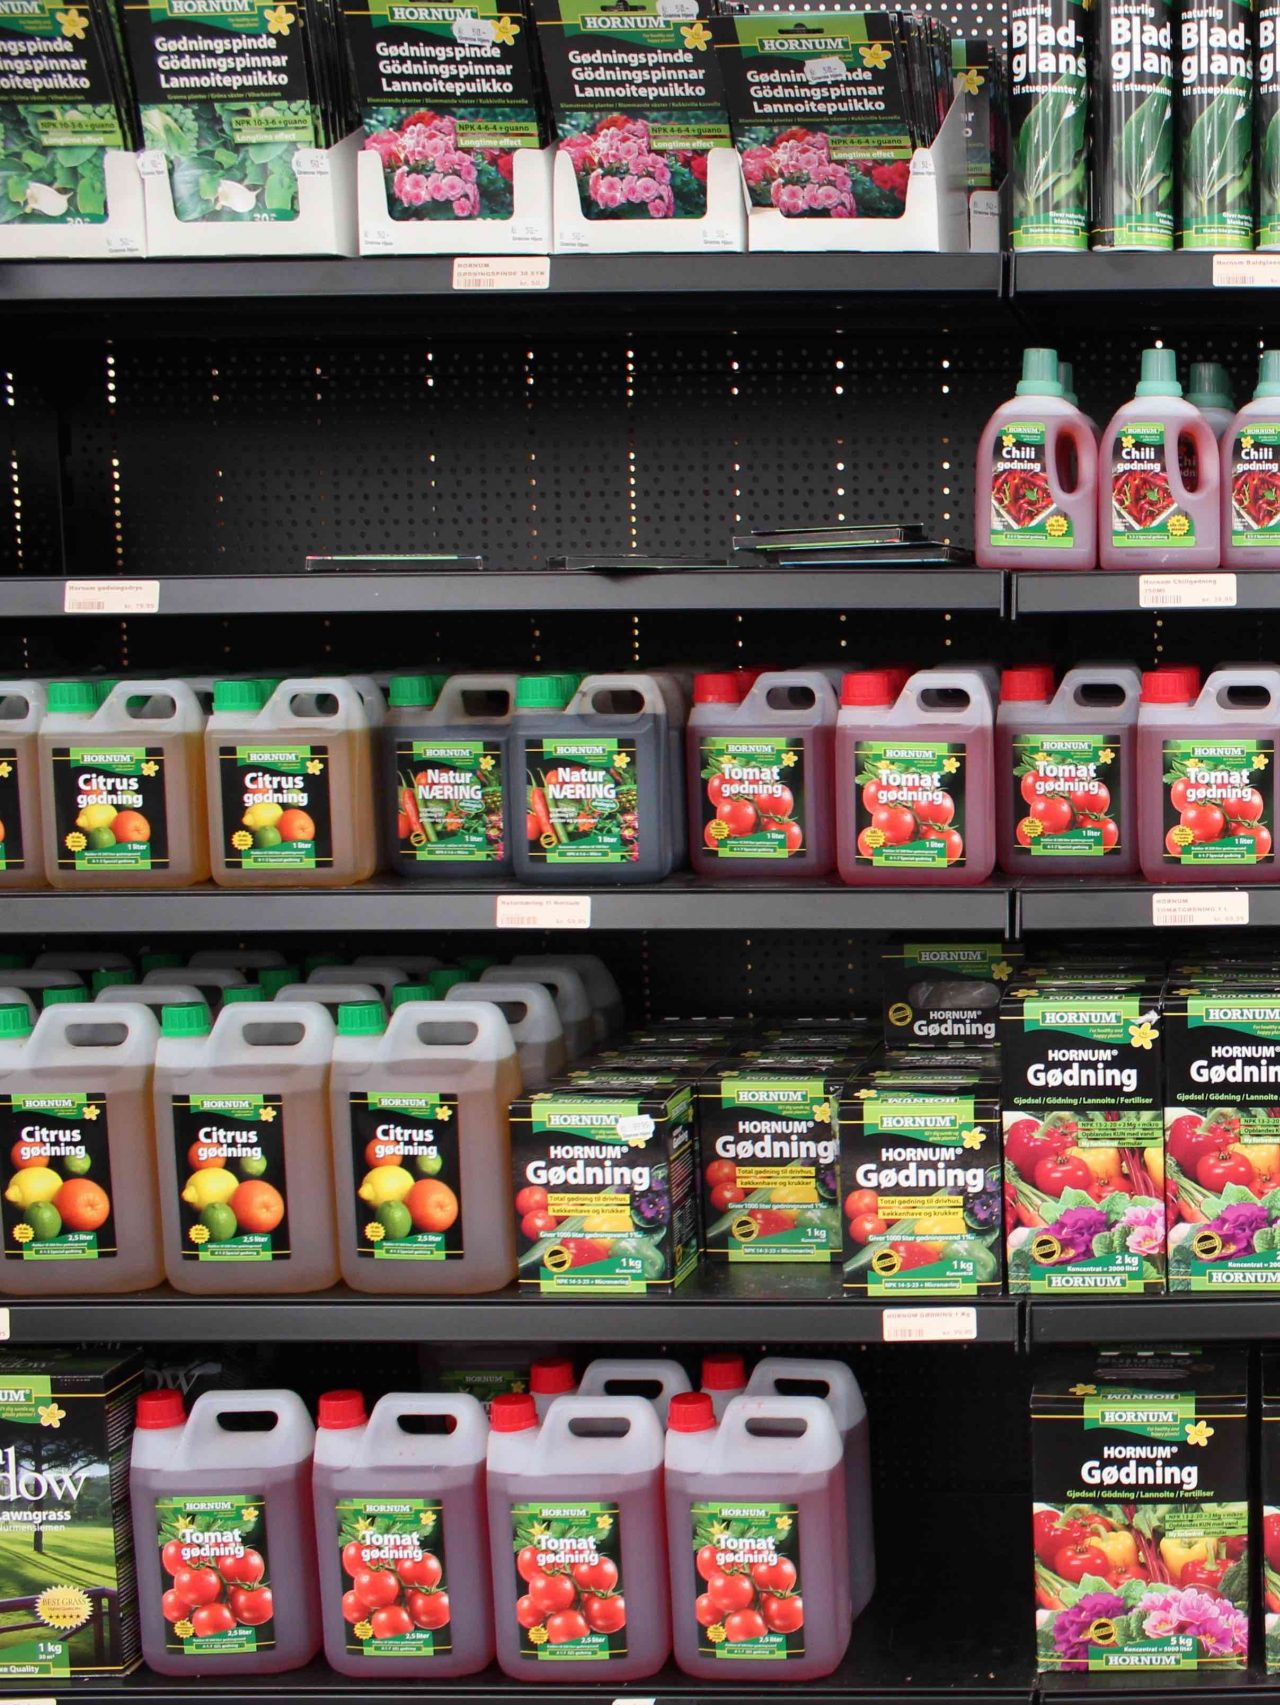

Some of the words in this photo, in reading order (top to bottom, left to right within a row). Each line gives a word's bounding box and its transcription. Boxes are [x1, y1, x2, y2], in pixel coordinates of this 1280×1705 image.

[1011, 4, 1054, 19] naturlig
[1011, 20, 1084, 49] Blad-
[1181, 22, 1251, 50] Blad-
[154, 35, 277, 52] Gødningspinde
[376, 42, 501, 60] Gødningspinde
[158, 53, 289, 72] Gödningspinnar
[568, 50, 693, 66] Gødningspinde
[1011, 50, 1087, 81] glans
[379, 60, 513, 77] Gödningspinnar
[571, 67, 706, 84] Gödningspinnar
[1181, 52, 1253, 82] glans
[160, 71, 289, 89] Lannoitepuikko
[381, 78, 513, 95] Lannoitepuikko
[575, 83, 706, 100] Lannoitepuikko
[750, 83, 884, 100] Gödningspinnar
[1022, 83, 1077, 96] stueplanter
[753, 99, 885, 115] Lannoitepuikko
[651, 126, 669, 134] NPK
[670, 126, 690, 134] 4-6-4
[653, 140, 688, 150] Longtime
[689, 139, 714, 149] effect
[829, 137, 848, 147] NPK
[849, 137, 870, 146] 4-6-4
[832, 151, 868, 161] Longtime
[869, 150, 895, 159] effect
[1002, 446, 1036, 459] Chili
[1122, 447, 1156, 459] Chili
[1241, 447, 1273, 460] Chili
[244, 773, 304, 789] Citrus
[426, 769, 472, 785] Natur
[557, 767, 606, 783] Natur
[723, 764, 779, 781] Tomat
[880, 770, 941, 787] Tomat
[1187, 766, 1250, 784] Tomat
[77, 774, 139, 791] Citrus
[549, 783, 616, 799] NÆRING
[721, 781, 781, 798] gødning
[418, 784, 482, 800] NÆRING
[1186, 784, 1252, 801] gødning
[604, 835, 617, 843] liter
[1027, 1064, 1137, 1091] Gødning
[1013, 1095, 1042, 1105] Gjødsel
[1047, 1096, 1079, 1106] Gödning
[1083, 1095, 1114, 1104] Lannoite
[1119, 1095, 1153, 1104] Fertiliser
[21, 1125, 82, 1143] Citrus
[198, 1127, 258, 1144] Citrus
[376, 1125, 434, 1143] Citrus
[20, 1142, 86, 1159] gødning
[375, 1141, 437, 1158] gødning
[715, 1136, 835, 1164] Gødning
[526, 1161, 651, 1190] Gødning
[628, 1257, 642, 1269] kg
[1116, 1256, 1121, 1264] 2
[1123, 1255, 1138, 1266] kg
[1081, 1461, 1198, 1488] Gødning
[182, 1529, 242, 1544] Tomat
[537, 1534, 596, 1550] Tomat
[717, 1535, 775, 1550] Tomat
[180, 1543, 245, 1560] gødning
[1171, 1637, 1175, 1645] 5
[1179, 1636, 1192, 1648] kg
[10, 1664, 40, 1675] Quality
